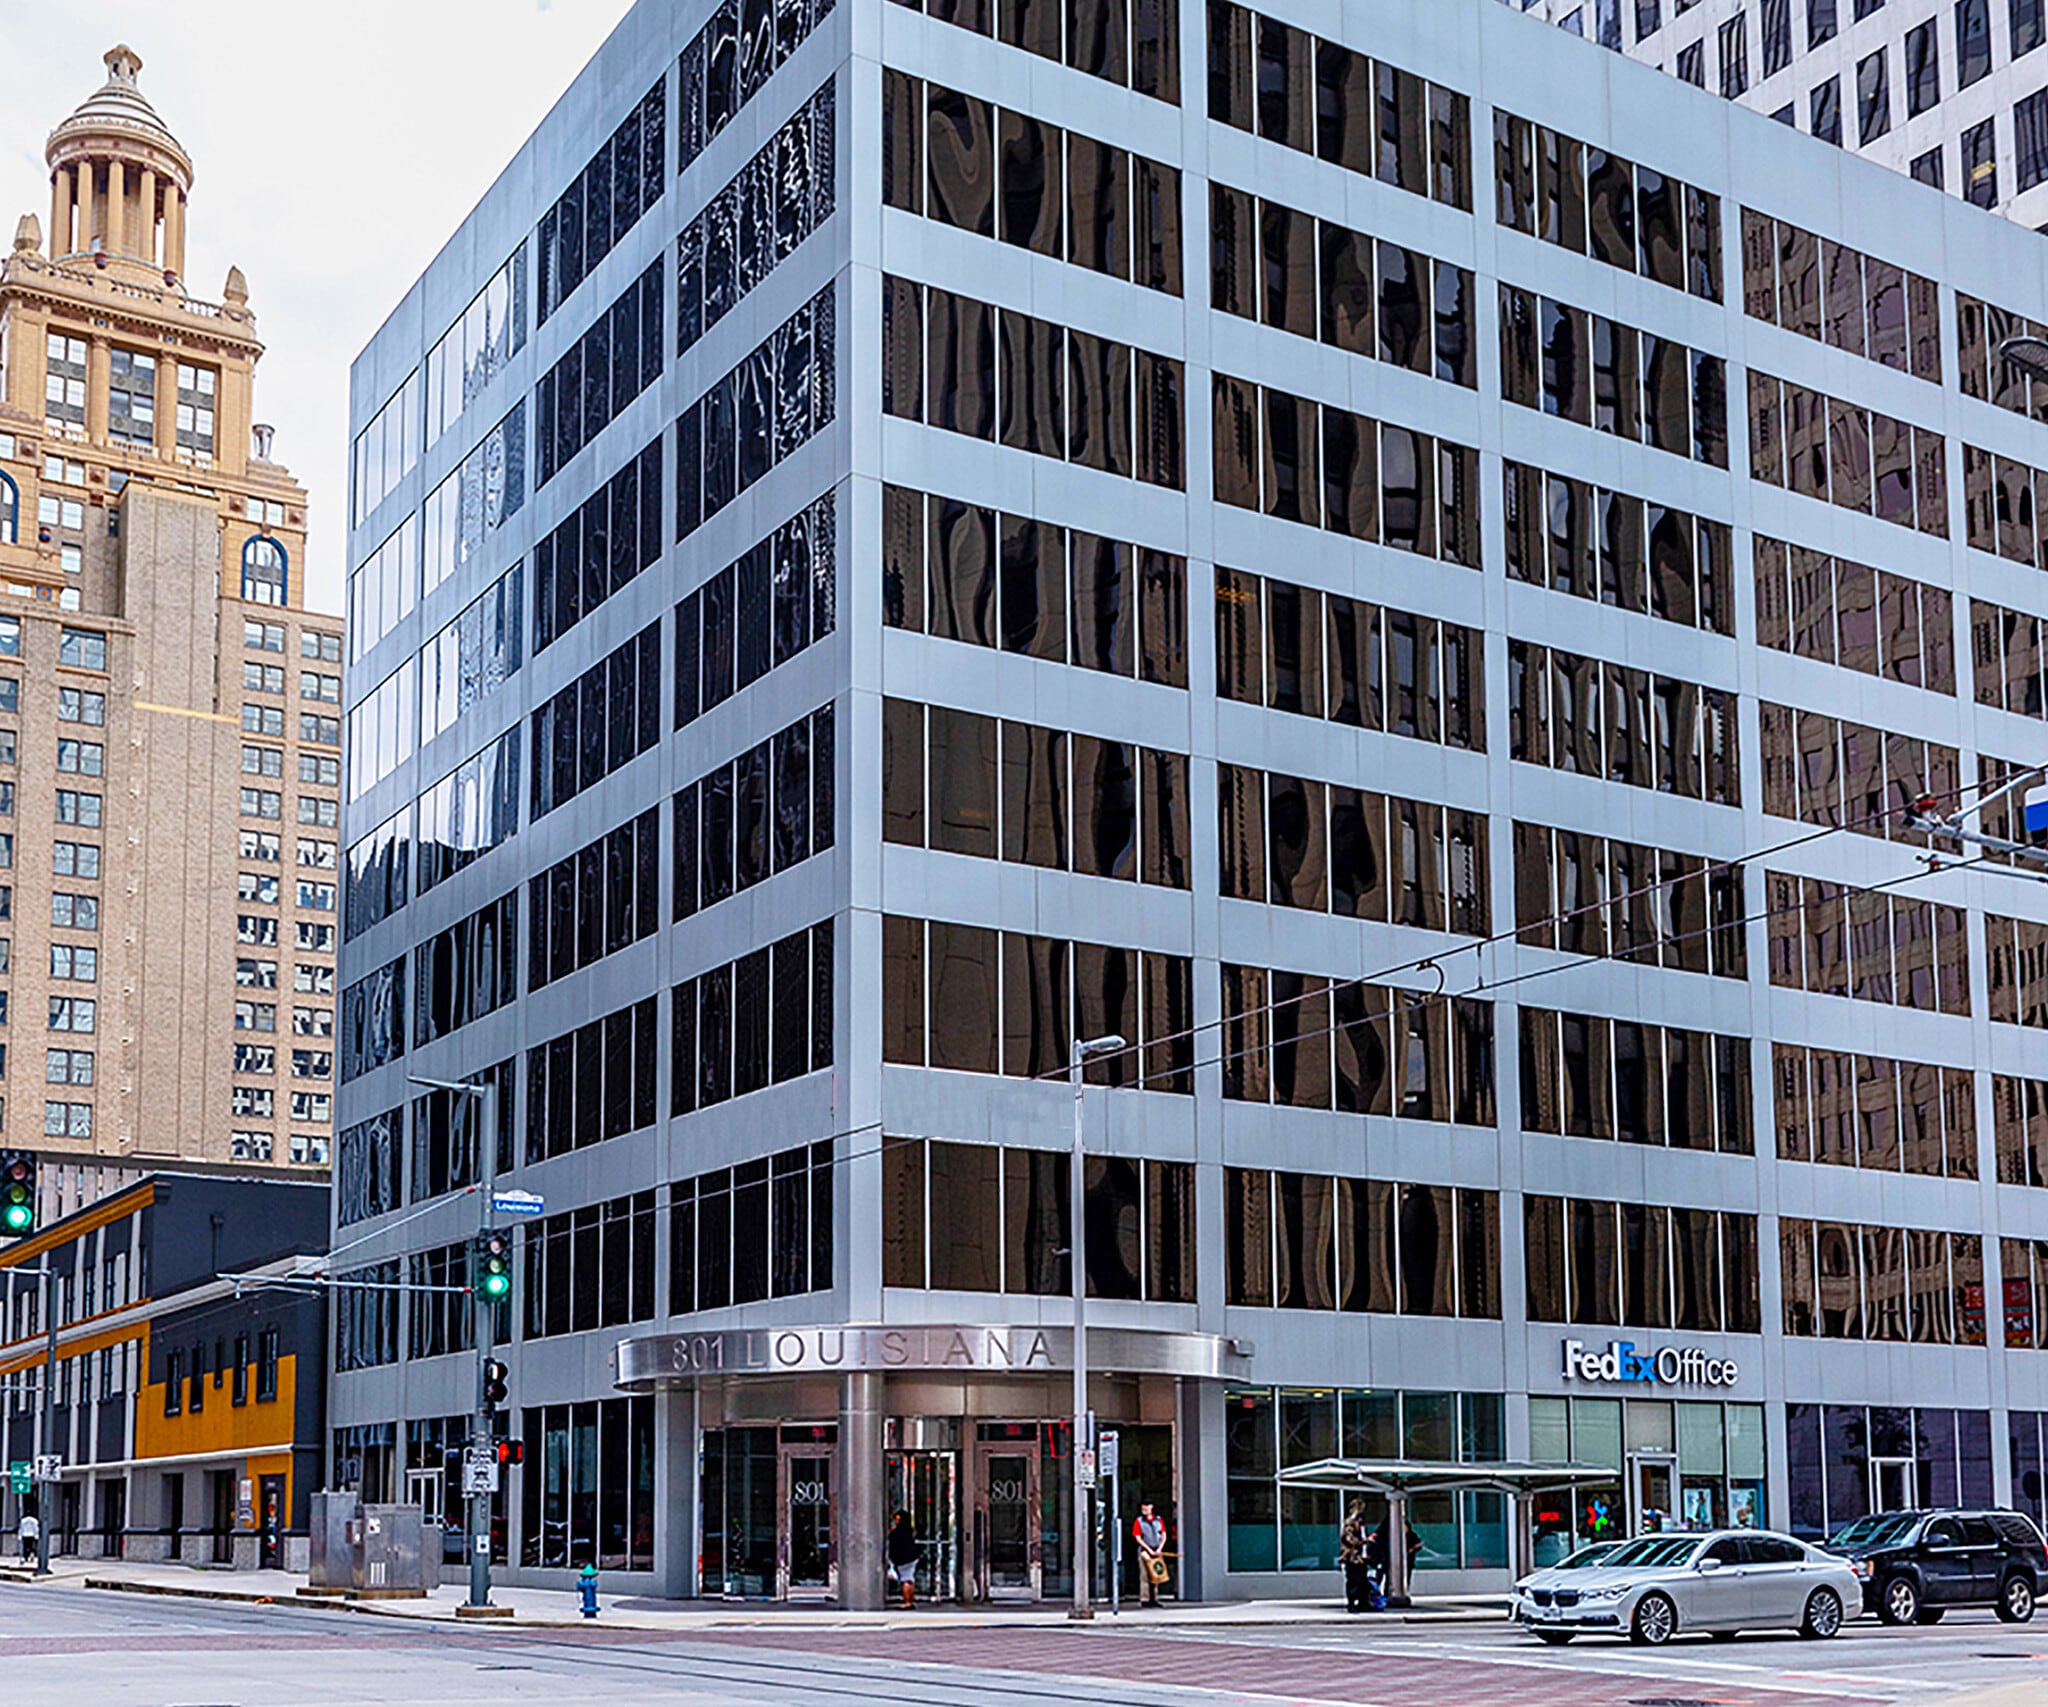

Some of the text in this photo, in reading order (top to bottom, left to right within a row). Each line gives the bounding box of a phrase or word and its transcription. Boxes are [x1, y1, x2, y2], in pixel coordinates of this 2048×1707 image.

[672, 1331, 1056, 1371] 801 LOUISIANA
[1562, 1339, 1738, 1385] FedEx Office
[795, 1481, 824, 1501] 801
[992, 1480, 1022, 1500] 801
